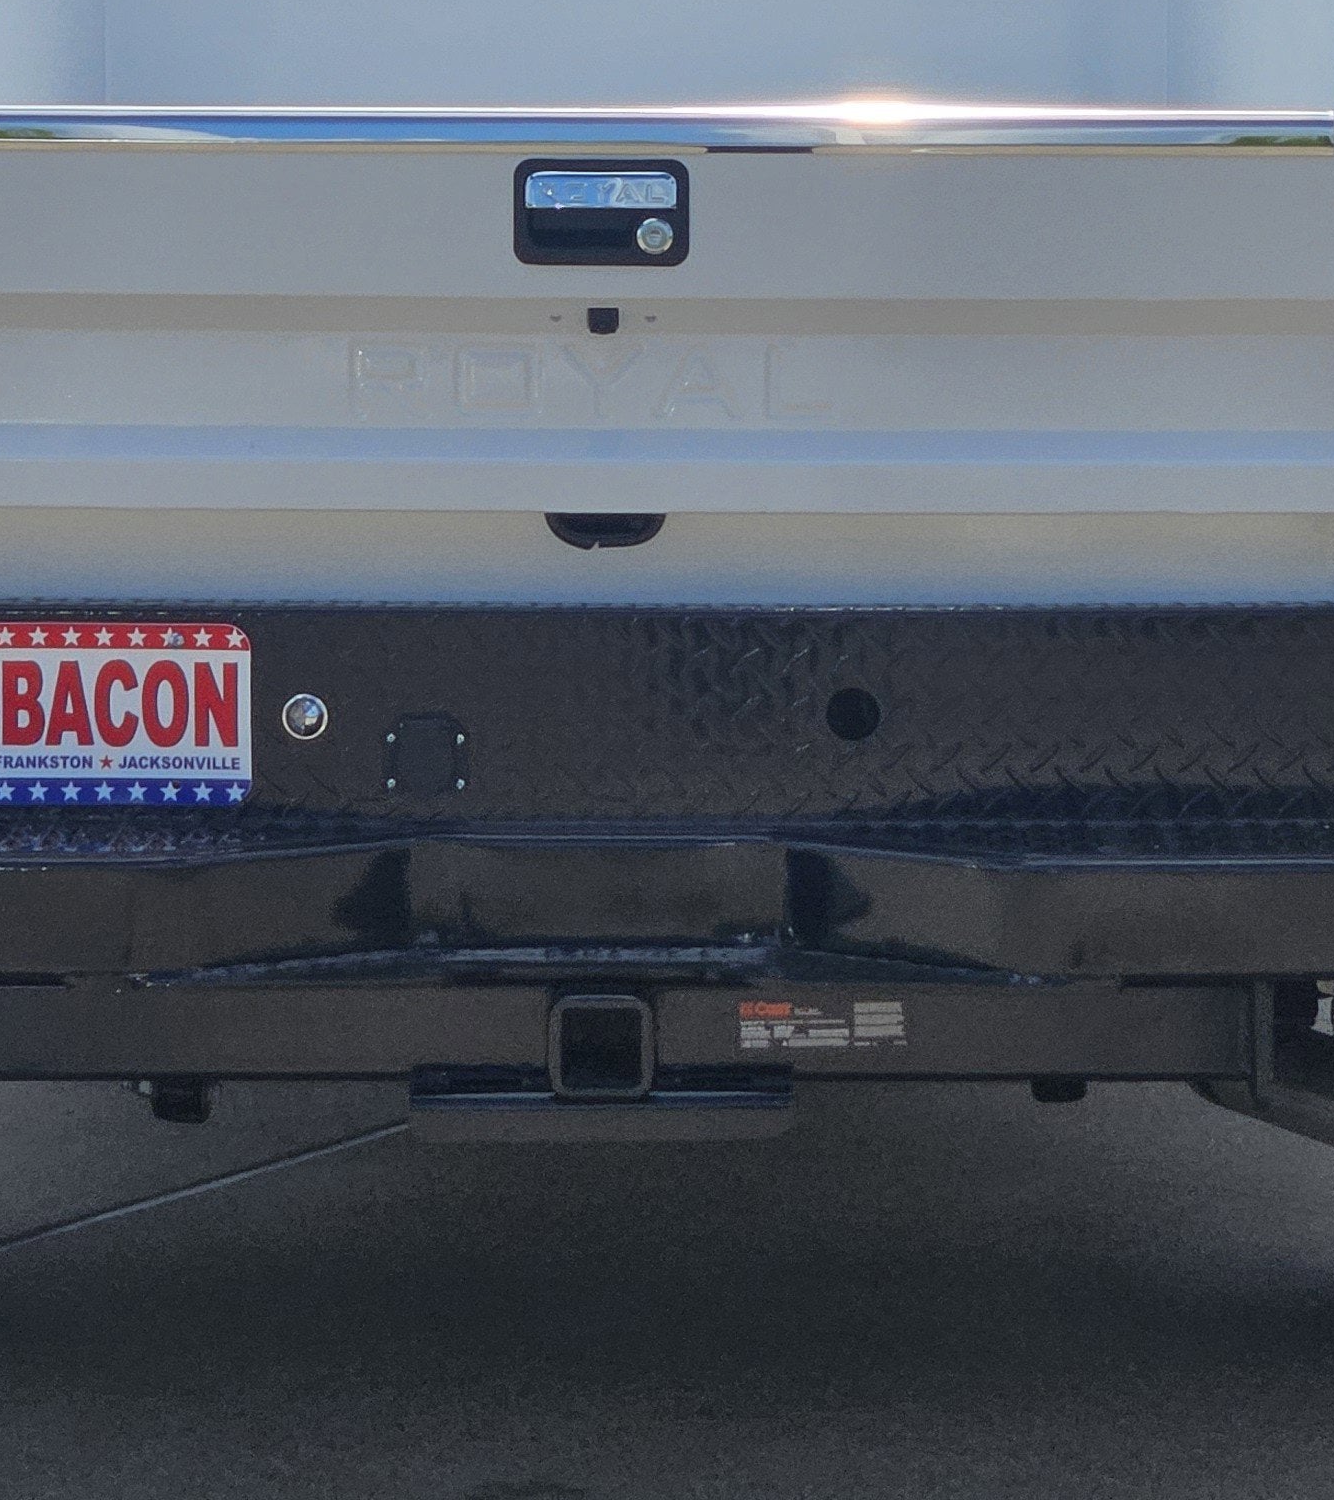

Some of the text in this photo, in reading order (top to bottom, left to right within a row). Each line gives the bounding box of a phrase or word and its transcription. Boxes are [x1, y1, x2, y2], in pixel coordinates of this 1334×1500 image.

[346, 338, 835, 420] ROYAL
[1, 658, 239, 748] BACON
[117, 754, 242, 772] JACKSONVILLE
